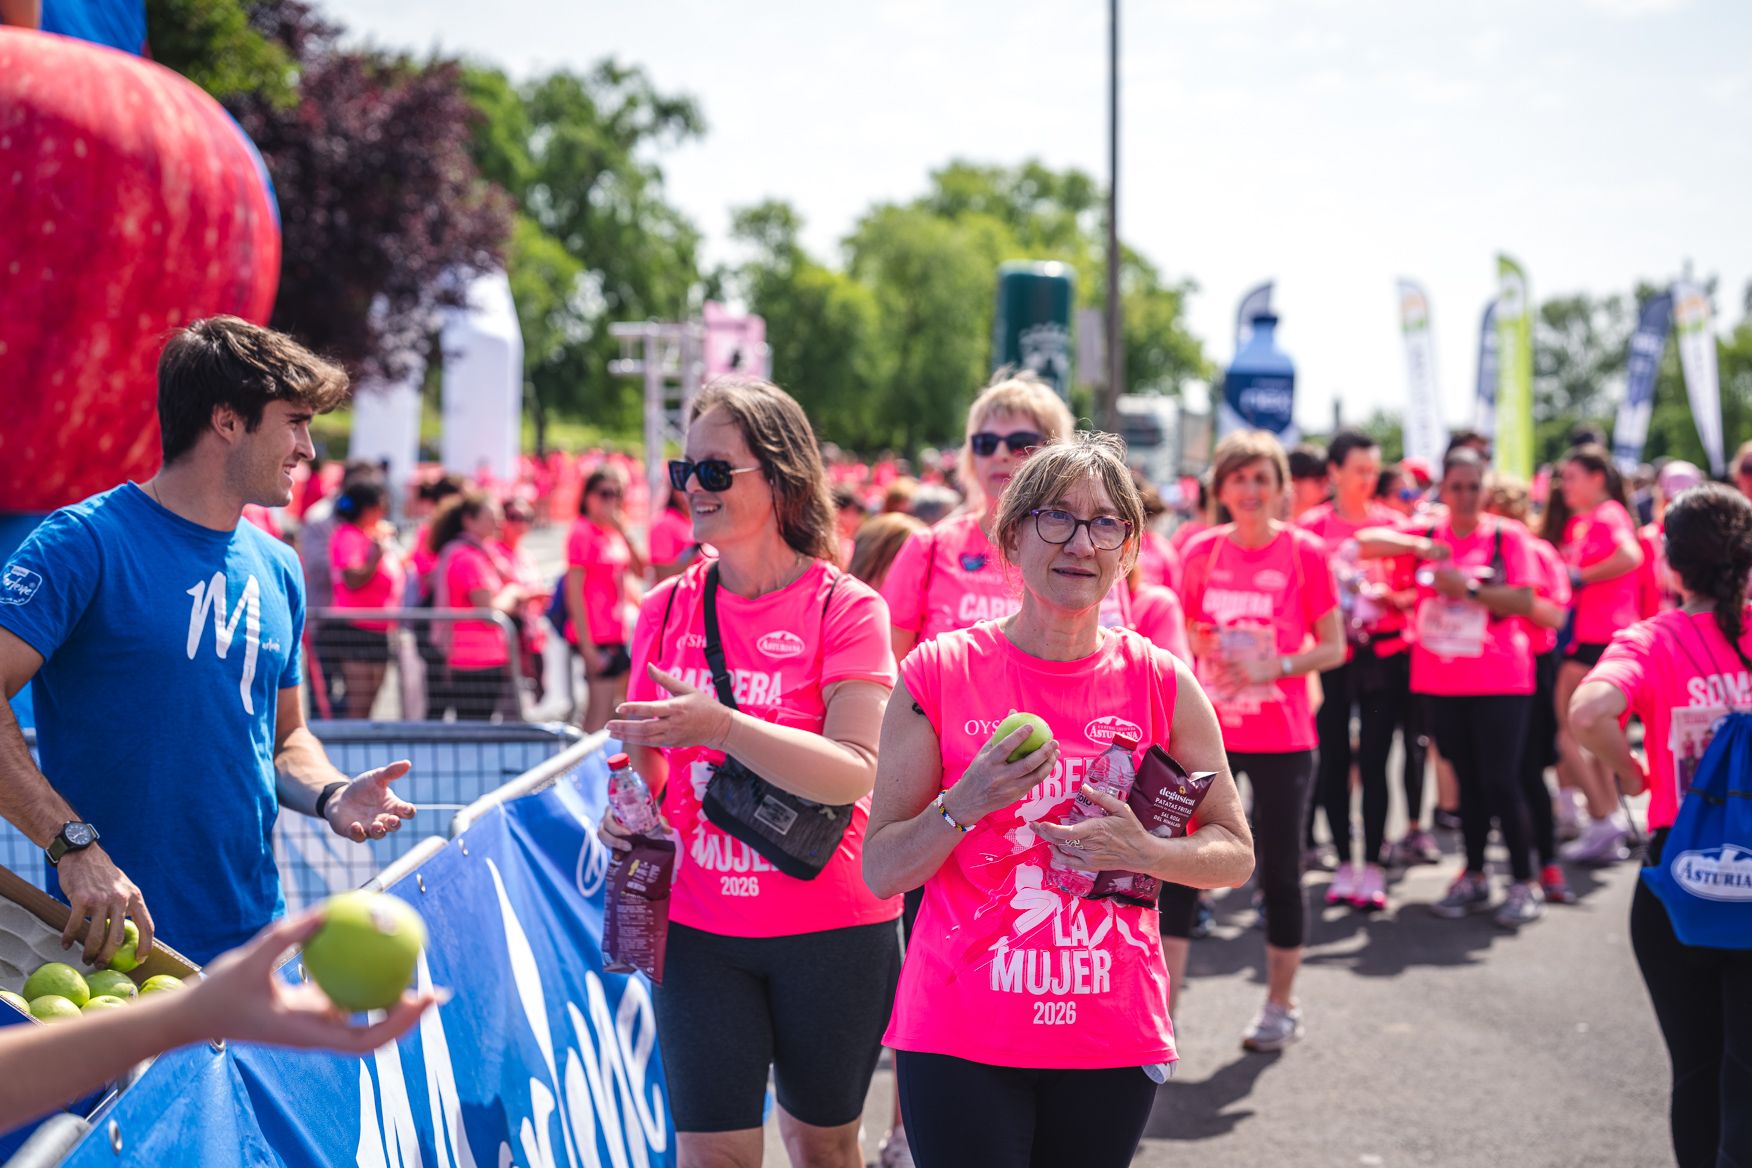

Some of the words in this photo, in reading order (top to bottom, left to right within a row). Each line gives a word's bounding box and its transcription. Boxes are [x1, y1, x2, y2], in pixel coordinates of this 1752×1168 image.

[958, 592, 1022, 621] CARR
[1687, 671, 1752, 709] SOM
[964, 719, 1000, 736] OYS
[1155, 798, 1178, 809] PATATAS
[720, 876, 760, 897] 2026
[1681, 860, 1752, 888] ASTURIA
[1054, 896, 1090, 947] LA
[990, 947, 1112, 995] MUJER
[1032, 1001, 1077, 1025] 2026
